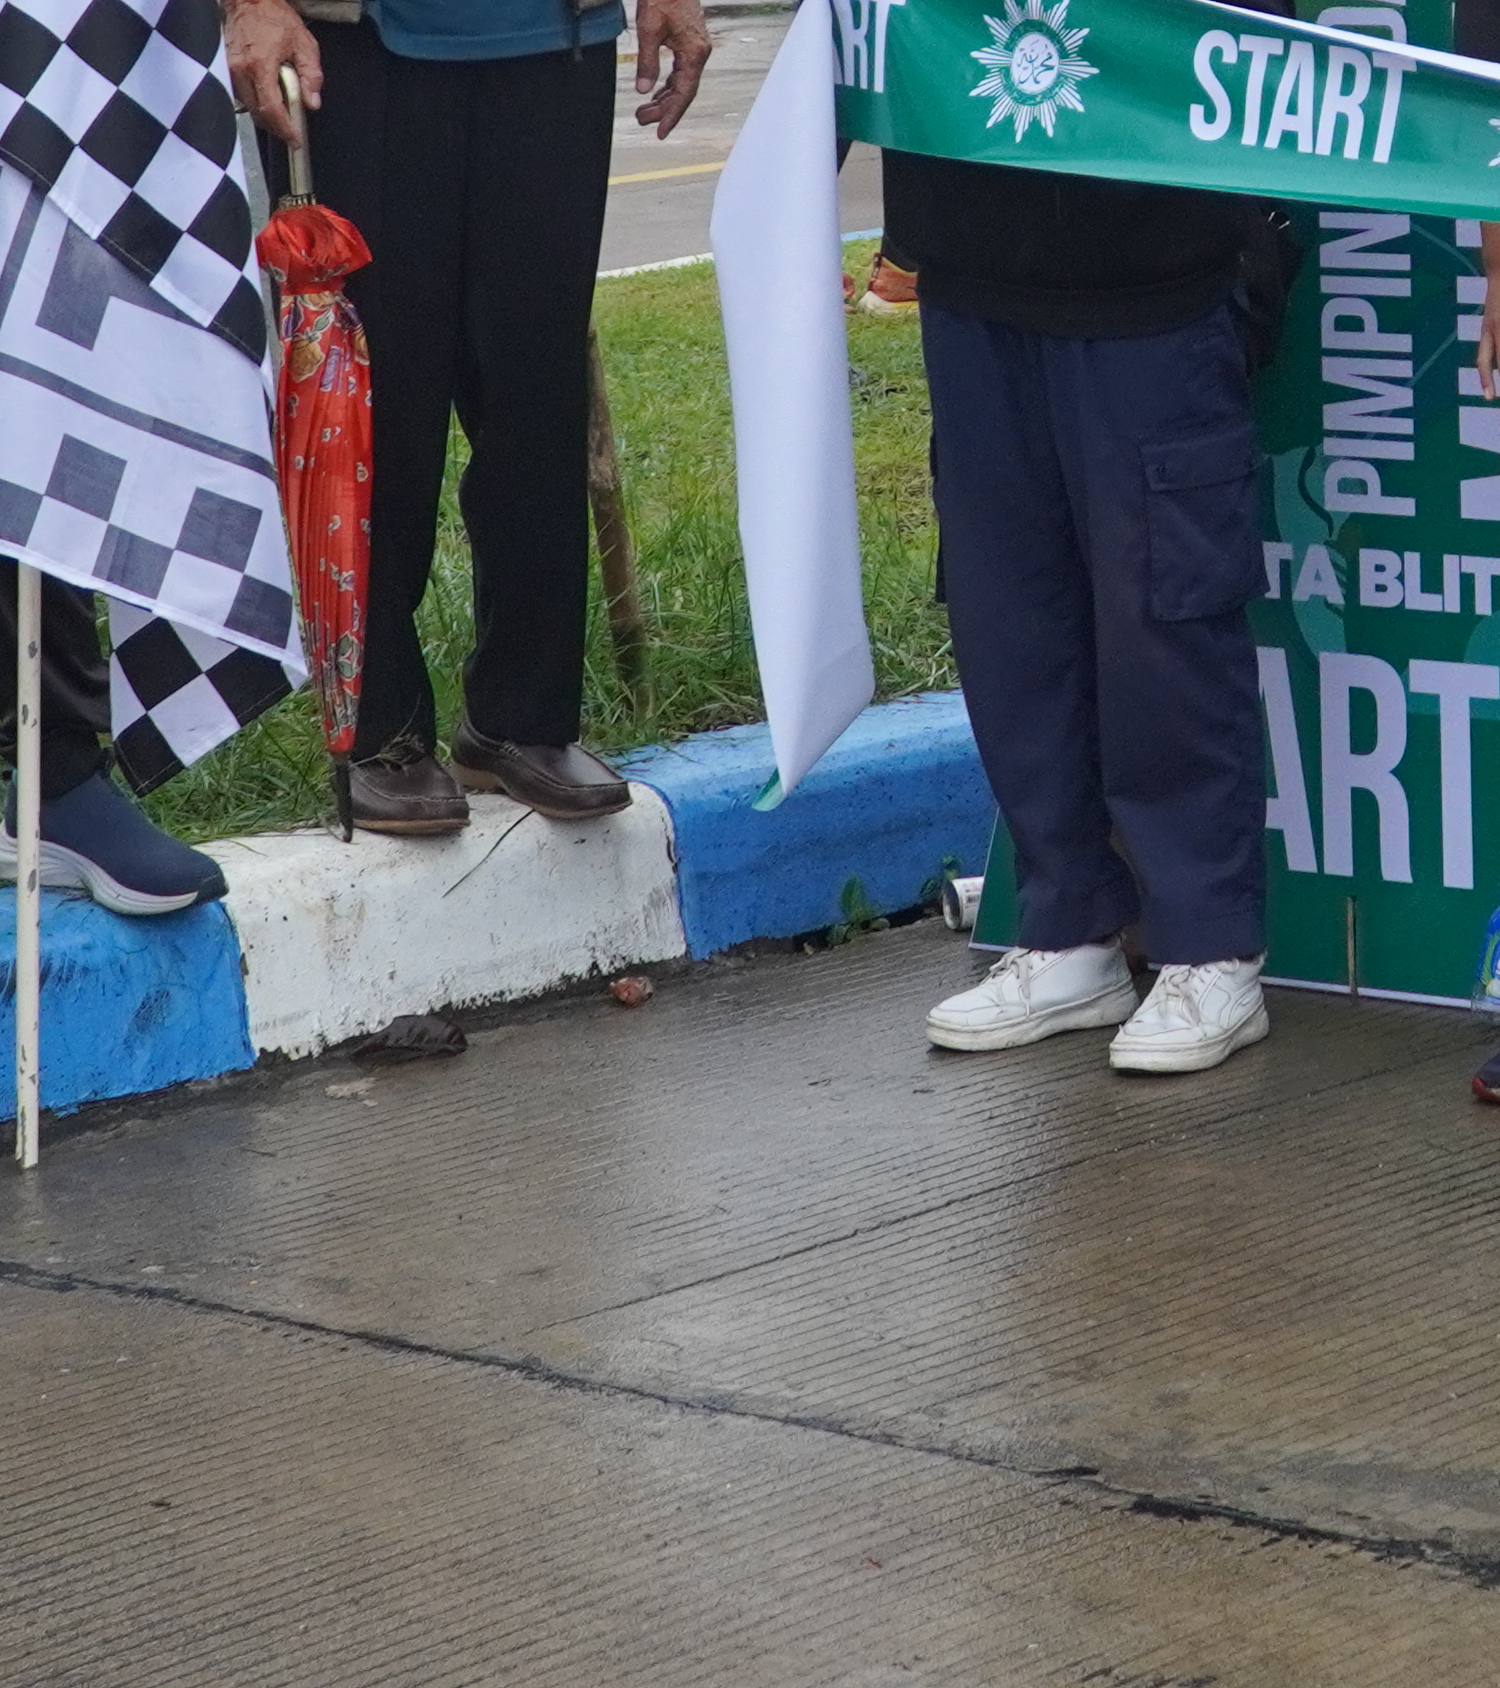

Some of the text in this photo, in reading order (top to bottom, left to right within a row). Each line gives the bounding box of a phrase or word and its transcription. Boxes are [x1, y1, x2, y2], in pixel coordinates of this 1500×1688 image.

[1189, 28, 1417, 165] START
[1319, 211, 1416, 517] PIMPIN
[1262, 542, 1346, 606] TA
[1257, 646, 1500, 891] ART
